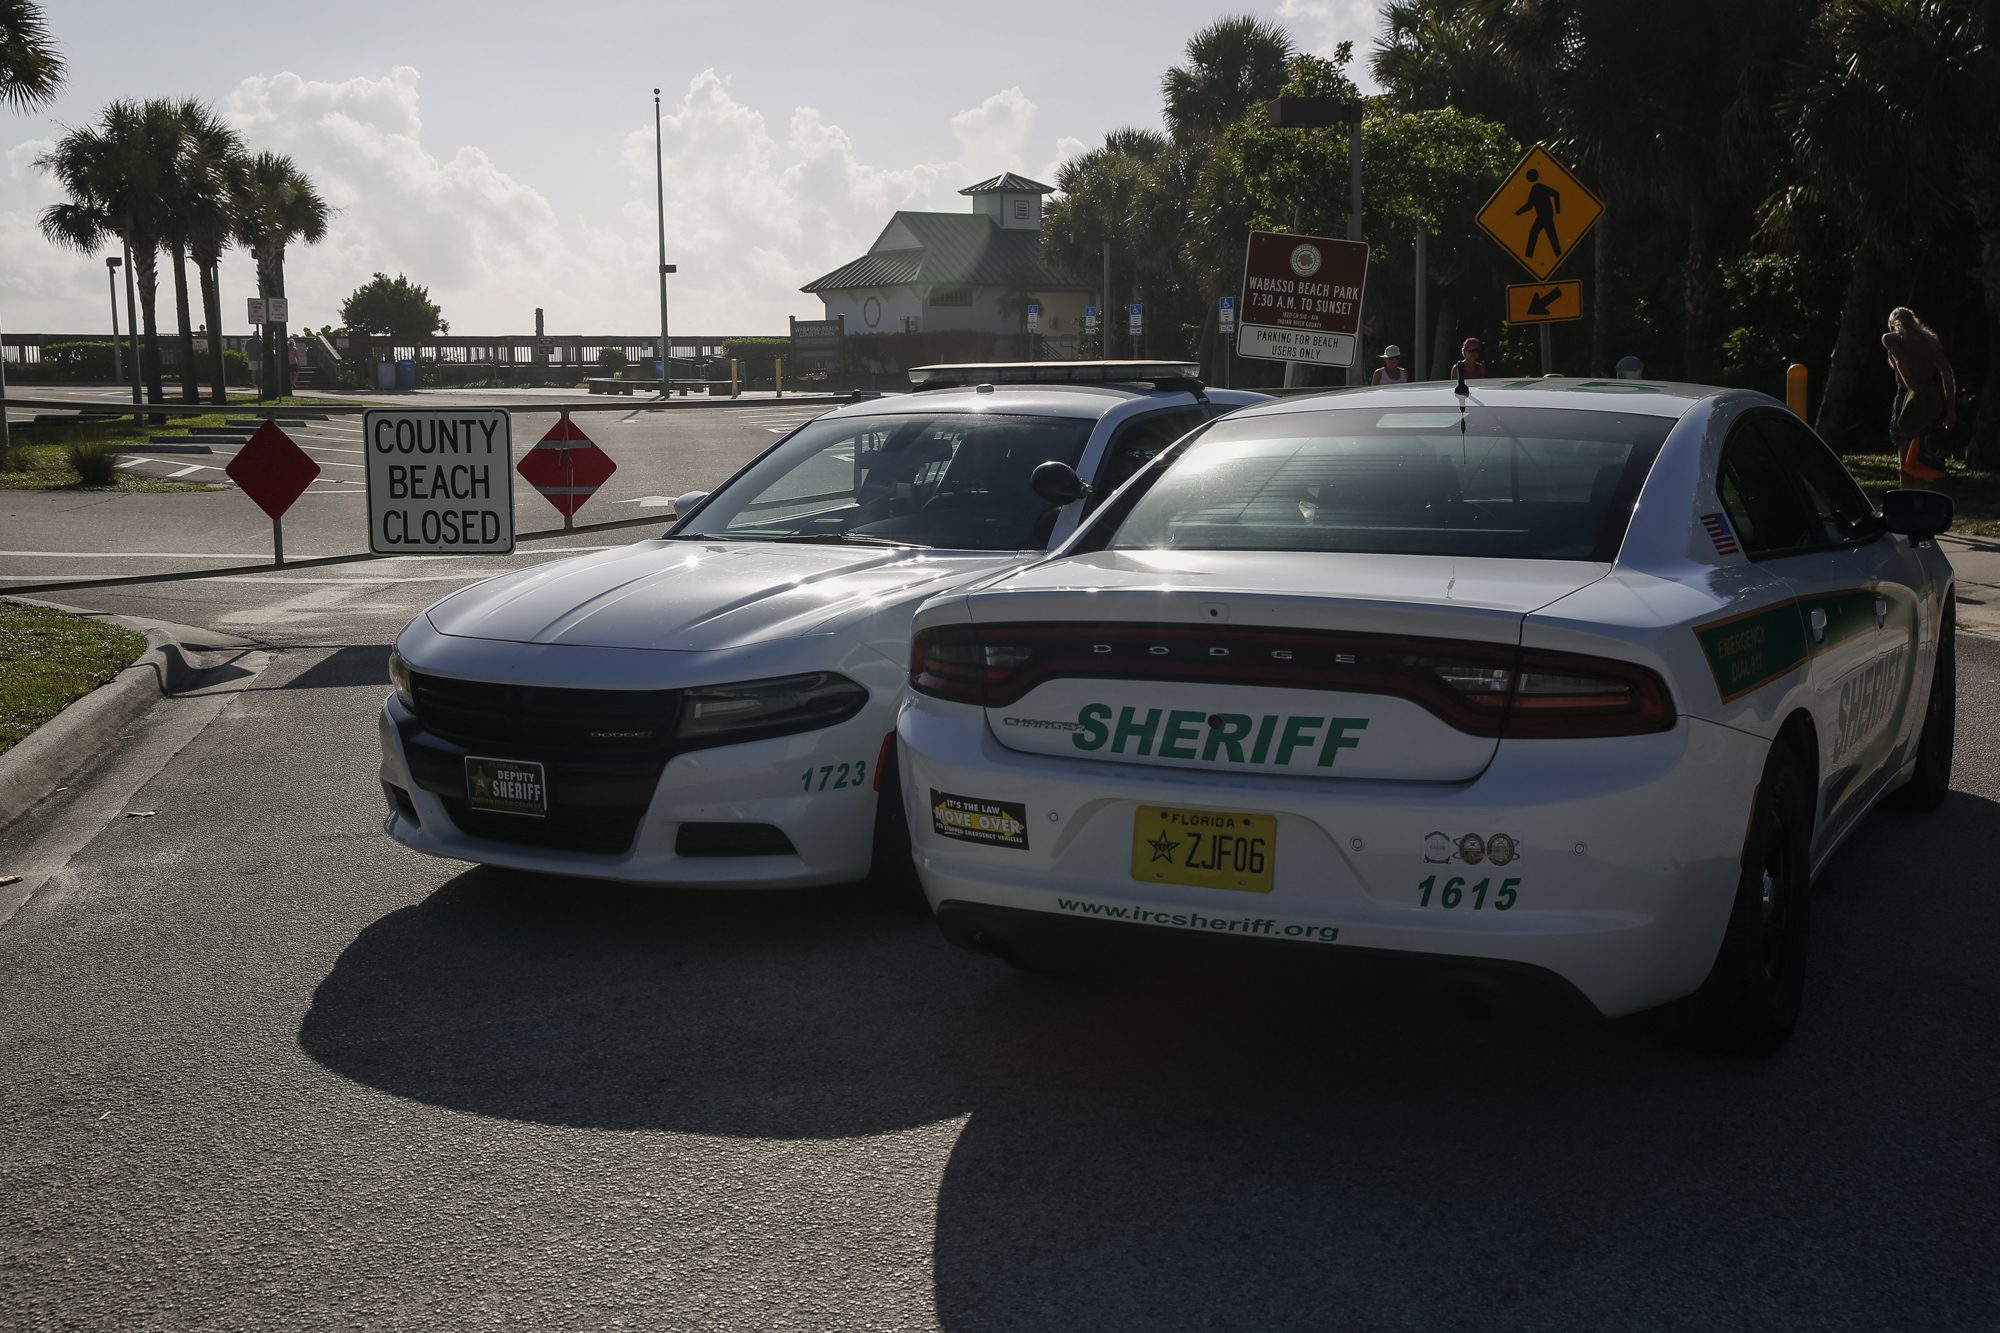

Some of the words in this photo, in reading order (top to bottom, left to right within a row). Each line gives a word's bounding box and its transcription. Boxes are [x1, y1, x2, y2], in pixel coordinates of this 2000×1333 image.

[1249, 277, 1294, 293] WABASSO
[1298, 282, 1330, 297] BEACH
[1333, 286, 1359, 300] PARK
[1252, 292, 1274, 307] 7:30
[1276, 295, 1297, 310] A.M.
[1301, 297, 1313, 311] TO
[1315, 300, 1353, 316] SUNSET
[1276, 318, 1292, 326] INDIAN
[1293, 319, 1305, 327] RIVER
[1305, 321, 1322, 329] COUNTY
[1257, 330, 1292, 344] PARKING
[1294, 334, 1310, 346] FOR
[1313, 335, 1339, 348] BEACH
[1271, 345, 1297, 357] USERS
[1300, 347, 1321, 359] ONLY
[375, 418, 499, 454] COUNTY
[388, 464, 490, 499] BEACH
[383, 509, 500, 545] CLOSED
[1718, 623, 1766, 659] EMERGENCY
[1093, 643, 1357, 664] DODGE
[1731, 659, 1750, 682] DIAL
[1751, 654, 1763, 674] 911
[1003, 716, 1087, 732] CHARGER
[1071, 702, 1370, 768] SHERIFF
[497, 769, 535, 783] DEPUTY
[801, 760, 867, 793] 1723
[492, 779, 541, 801] SHERIFF
[946, 799, 961, 809] IT'S
[963, 802, 979, 812] THE
[981, 805, 1000, 815] LAW
[935, 806, 971, 828] MOVE
[978, 816, 1022, 834] OVER
[1171, 813, 1235, 828] FLORIDA
[965, 828, 996, 840] EMERGENCY
[997, 834, 1024, 843] VEHICLES
[1185, 832, 1266, 874] ZJF06
[1417, 874, 1521, 911] 1615
[1057, 898, 1340, 942] www.ircsheriff.org
